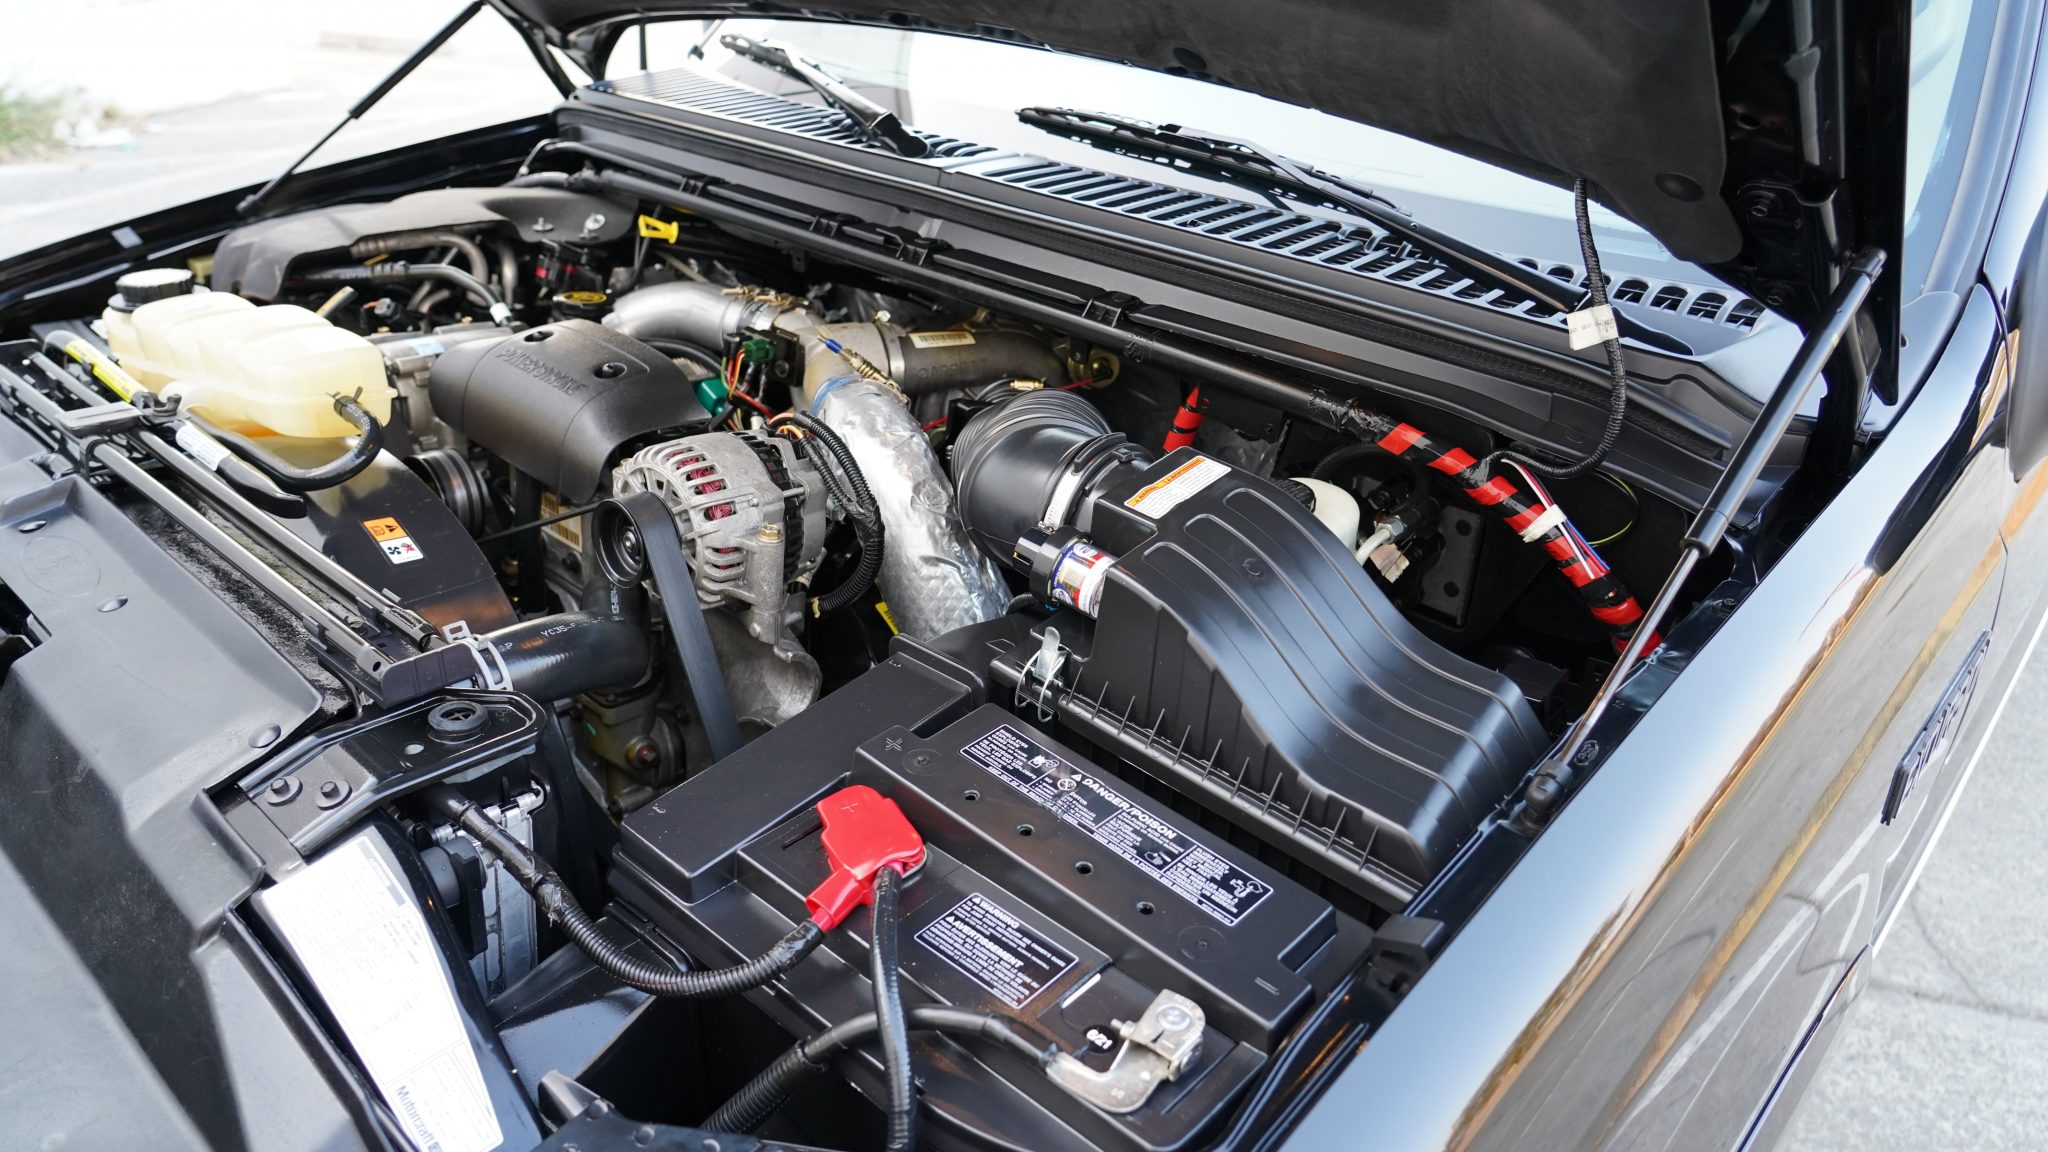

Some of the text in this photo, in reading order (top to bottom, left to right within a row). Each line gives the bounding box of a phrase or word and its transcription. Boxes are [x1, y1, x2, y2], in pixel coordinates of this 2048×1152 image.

[1079, 777, 1178, 839] DANGER/POISON
[977, 900, 1021, 929] WARNING
[951, 919, 1025, 969] AVERTISSEMENT
[395, 1085, 436, 1143] Motorcraft
